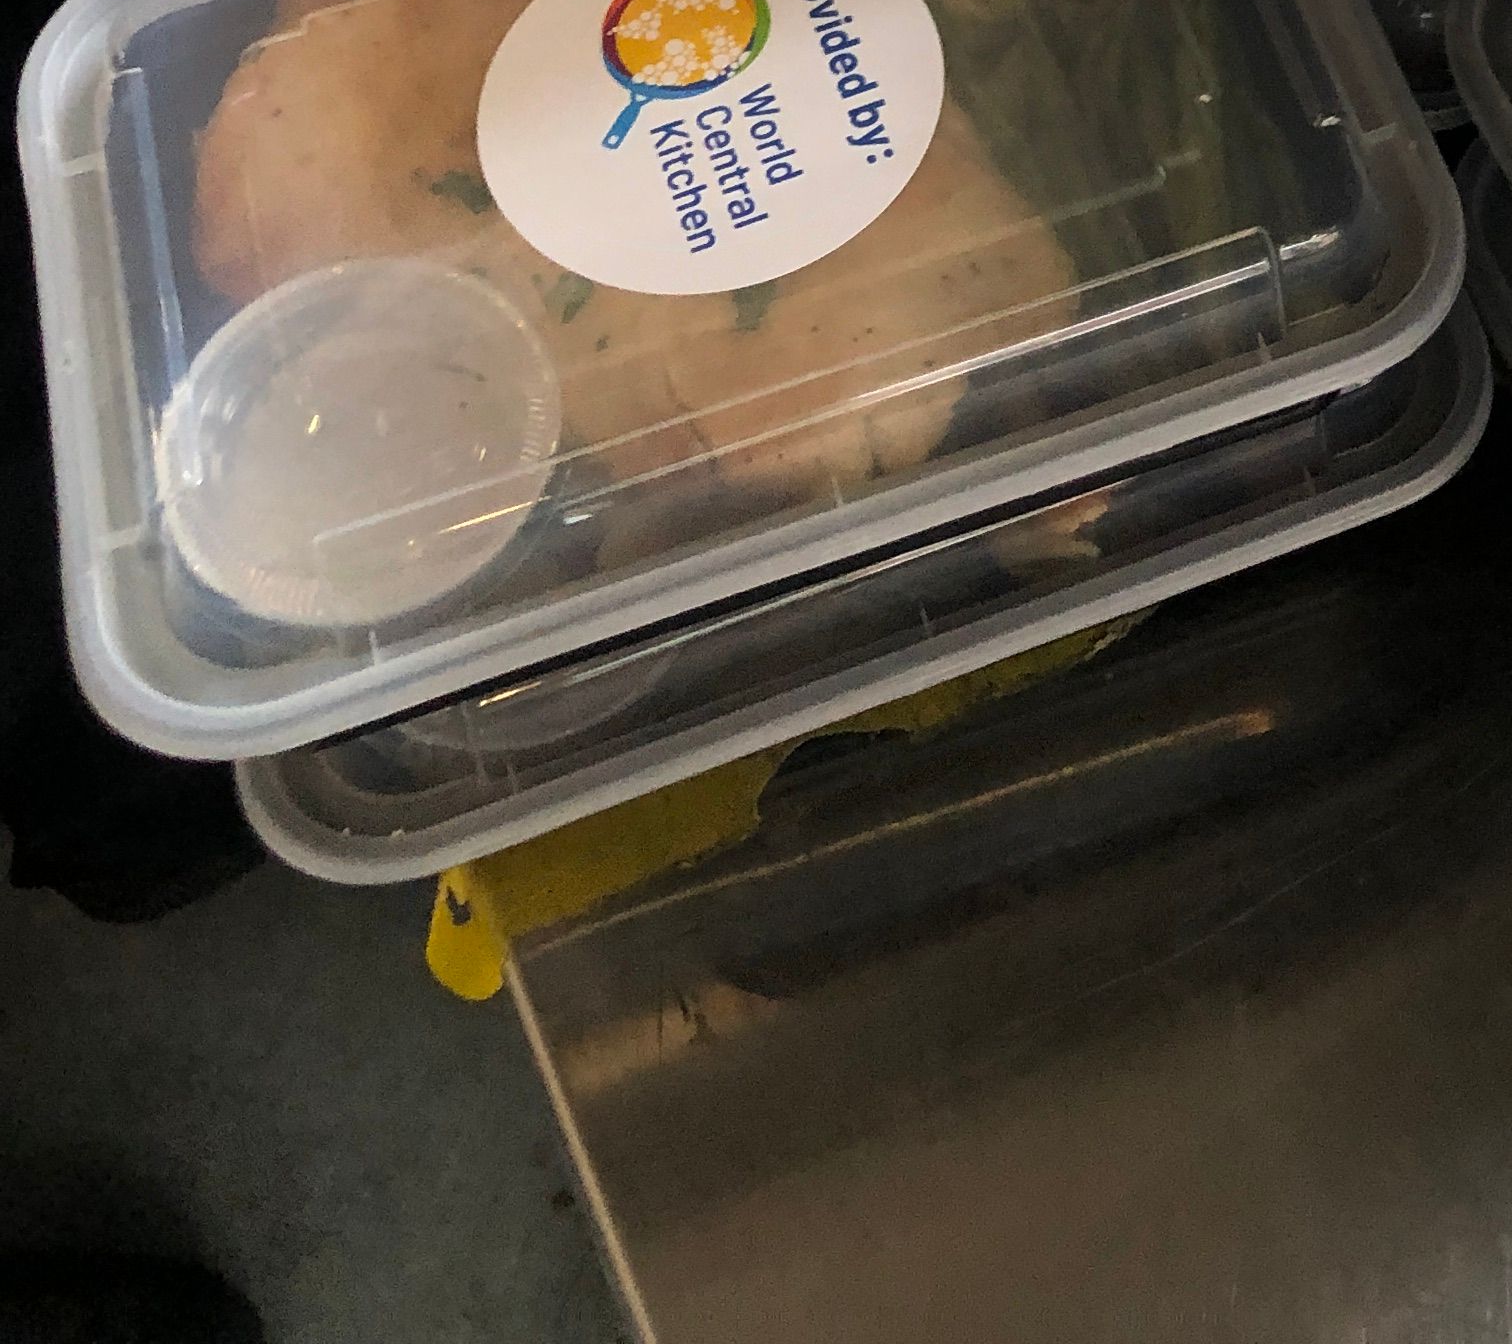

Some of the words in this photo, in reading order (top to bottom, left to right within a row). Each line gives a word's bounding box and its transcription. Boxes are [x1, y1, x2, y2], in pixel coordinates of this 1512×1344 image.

[650, 120, 717, 254] Kitchen
[696, 106, 769, 230] Central
[739, 84, 804, 186] World
[846, 98, 894, 164] by:
